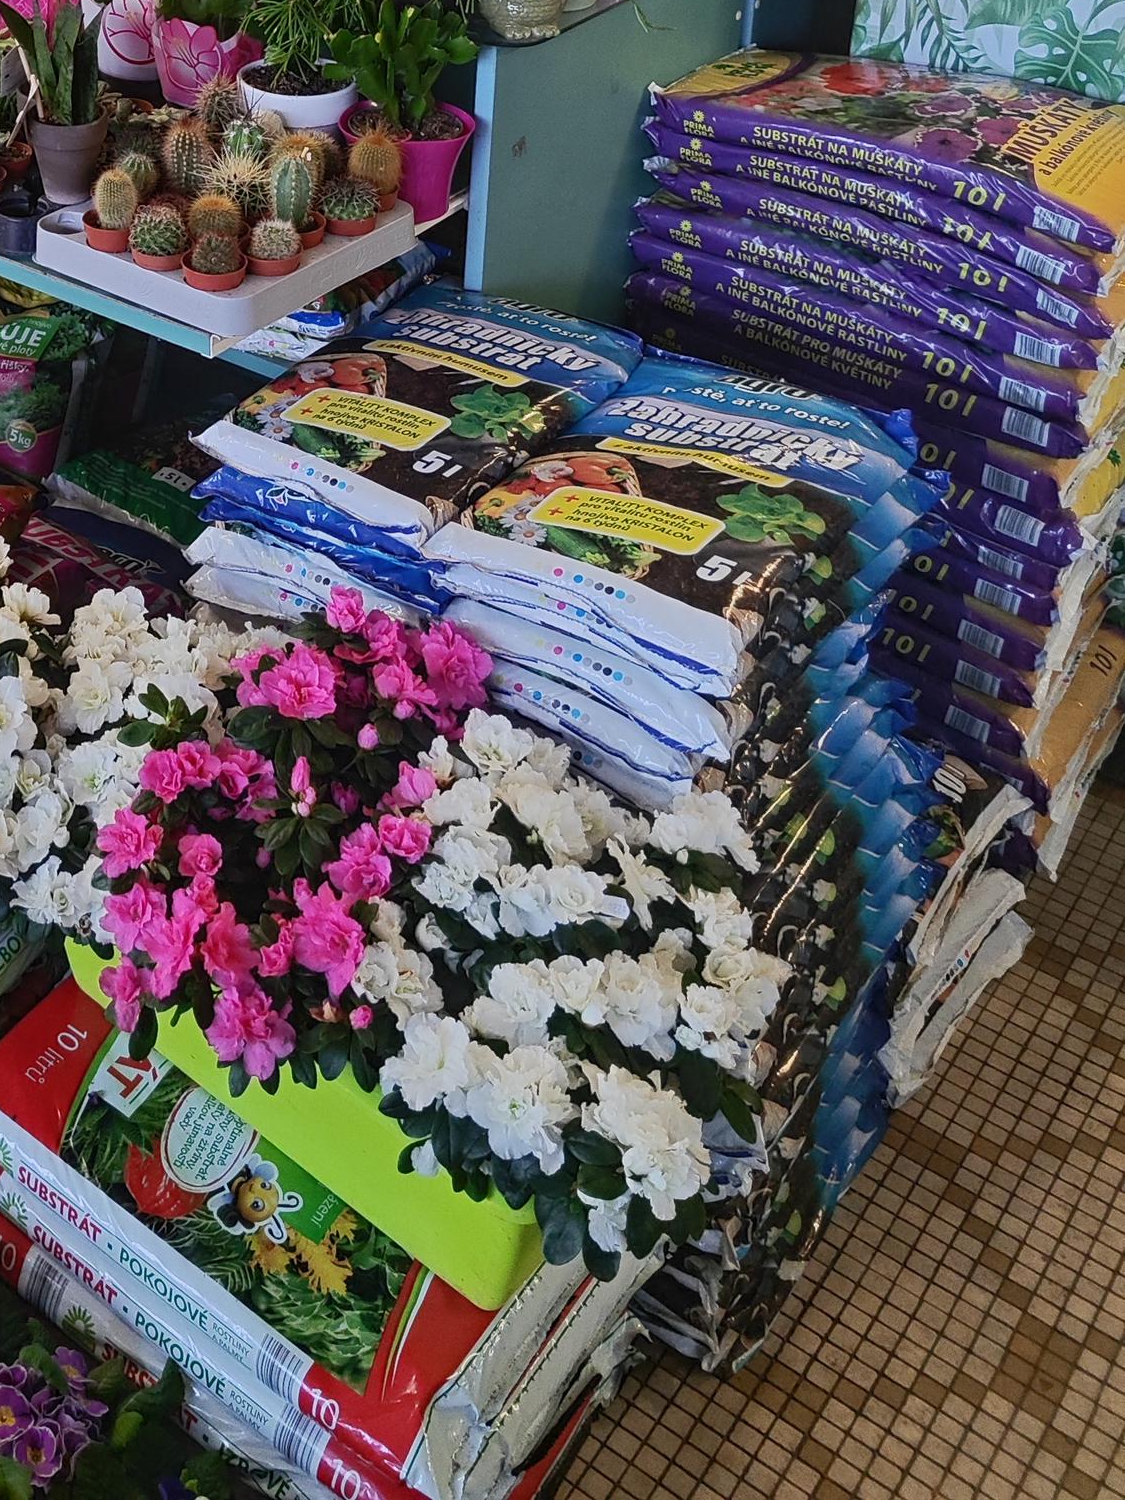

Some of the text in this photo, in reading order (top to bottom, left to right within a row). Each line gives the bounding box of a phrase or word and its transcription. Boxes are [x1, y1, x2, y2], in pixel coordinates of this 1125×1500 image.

[683, 120, 714, 134] PRIMA
[1006, 99, 1088, 161] MUŠKÁTY
[680, 147, 711, 161] PRIMA
[680, 154, 712, 167] FLORA
[753, 126, 923, 176] SUBSTRÁT NA MUŠKÁTY
[736, 164, 745, 173] A
[773, 172, 857, 204] BALKÓNOVÉ
[749, 155, 819, 178] SUBSTRÁT
[822, 172, 841, 186] NA
[691, 187, 722, 202] PRIMA
[953, 181, 989, 206] 10
[669, 227, 702, 242] PRIMA
[671, 234, 702, 249] FLORA
[759, 199, 927, 257] SUBSTRÁT NA MUŠKÁTY
[661, 258, 693, 273] PRIMA
[662, 265, 692, 281] FLORA
[740, 240, 906, 300] SUBSTRÁT NA MUŠKÁTY
[958, 262, 992, 287] 10
[726, 249, 923, 318] A INÉ BALKÓNOVÉ RASTLINY
[716, 282, 907, 362] A INÉ BALKÓNOVÉ RASTLINY
[731, 276, 893, 344] SUBSTRÁT NA MUŠKÁTY
[937, 307, 971, 333] 10
[9, 344, 36, 357] ploty
[385, 310, 600, 370] Zahradnický
[731, 309, 903, 380] SUBSTRÁT PRO MUŠKÁTY
[445, 355, 509, 381] humusem
[733, 324, 743, 335] A
[746, 326, 828, 368] BALKÓNOVÉ
[831, 359, 893, 390] KVĚTINY
[922, 351, 956, 377] 10
[338, 396, 436, 428] VITALITY KOMPLEX
[925, 383, 959, 410] 10
[312, 413, 326, 421] na
[320, 408, 421, 439] hnojivo KRISTALON
[327, 402, 420, 430] pro vitalitu rostlin
[784, 406, 851, 430] roste!
[606, 400, 864, 471] Zahradnický
[412, 450, 453, 474] 5
[565, 515, 631, 532] na 6 týdnů
[572, 508, 696, 542] hnojivo KRISTALON
[579, 501, 691, 532] pro vitalitu rostlin
[588, 495, 708, 529] VITALITY KOMPLEX
[696, 555, 738, 582] 5
[881, 627, 915, 655] 10
[25, 1024, 88, 1085] 10 litrů
[179, 1106, 197, 1131] vody
[204, 1122, 215, 1136] na
[311, 1194, 339, 1228] ázení
[18, 1166, 208, 1332] SUBSTRÁT POKOJOVÉ
[33, 1225, 227, 1399] SUBSTRÁT POKOJOVÉ
[212, 1323, 250, 1357] ROSTLINY
[230, 1390, 269, 1426] ROSTLINY
[311, 1388, 339, 1430] 10
[331, 1458, 361, 1500] 10
